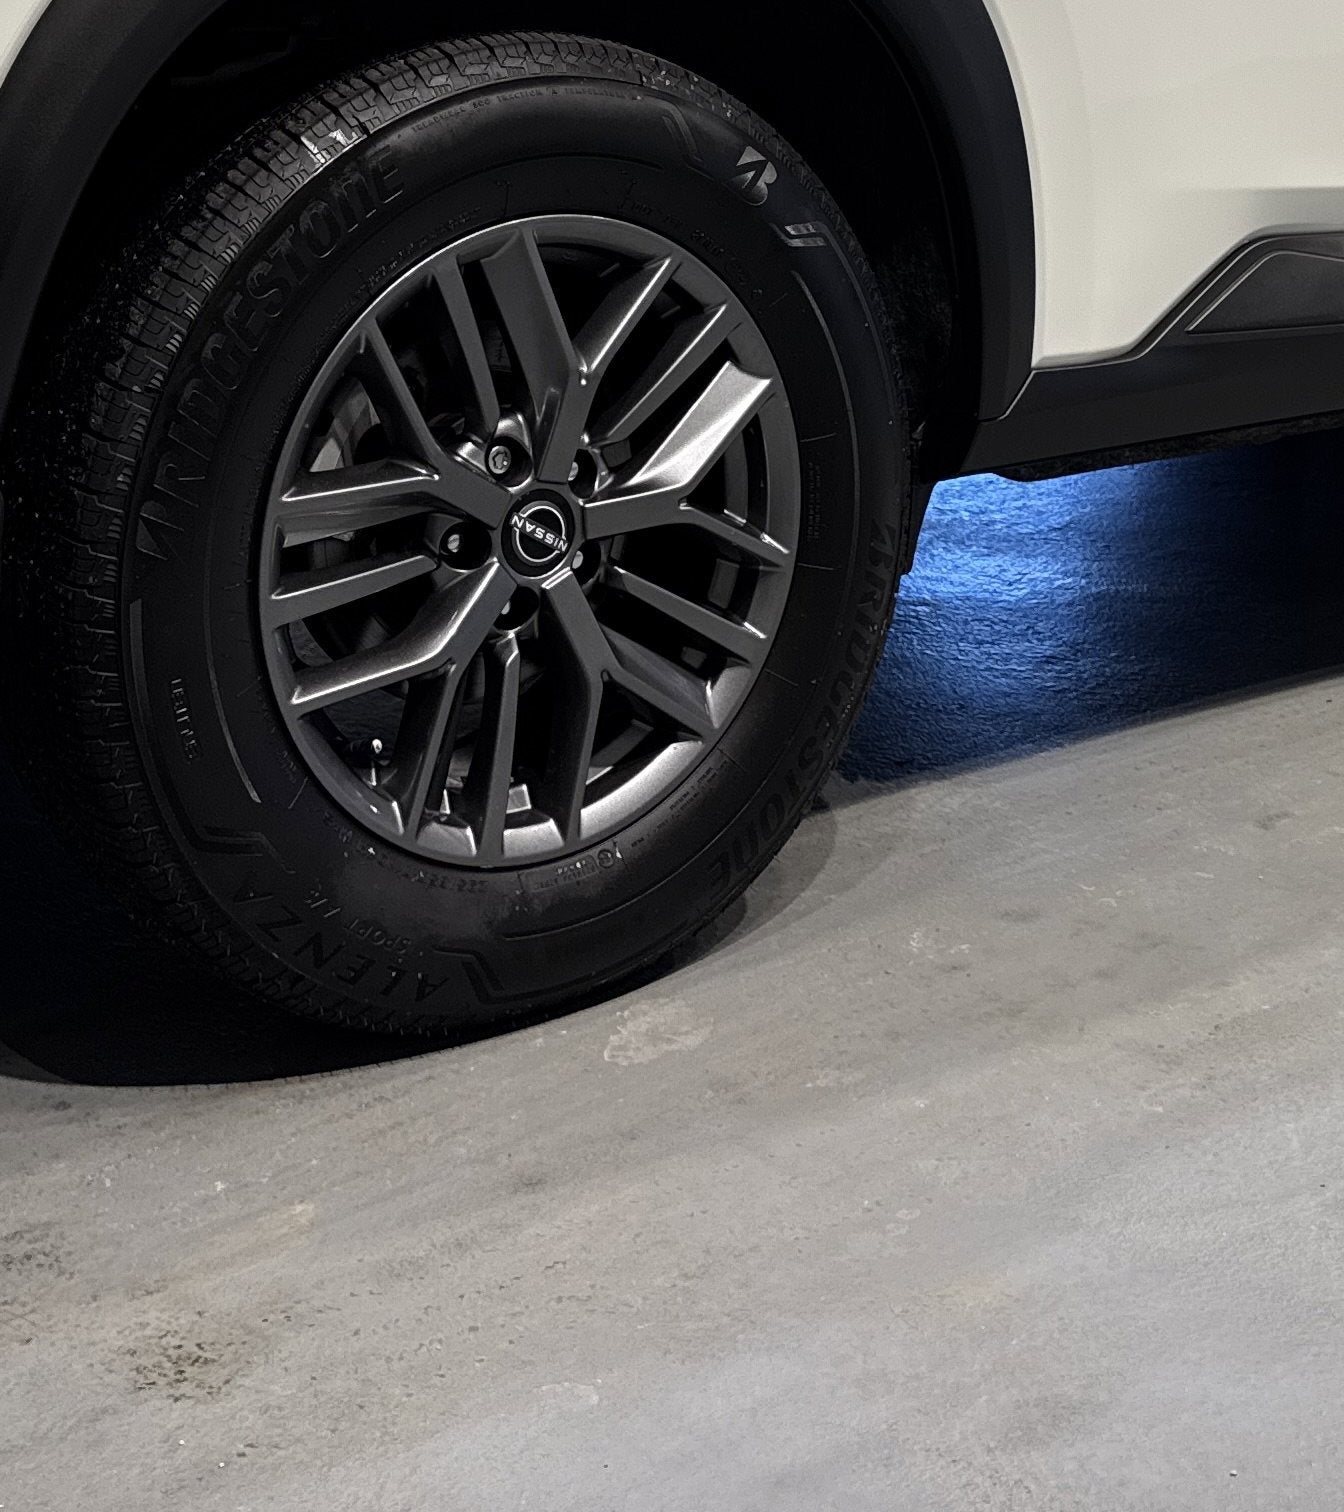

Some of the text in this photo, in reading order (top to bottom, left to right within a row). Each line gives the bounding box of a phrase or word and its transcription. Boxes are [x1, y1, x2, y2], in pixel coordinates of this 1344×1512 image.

[136, 144, 405, 562] BRIDGESTONE
[510, 514, 569, 553] NISSAN
[230, 882, 450, 1004] ALENZA
